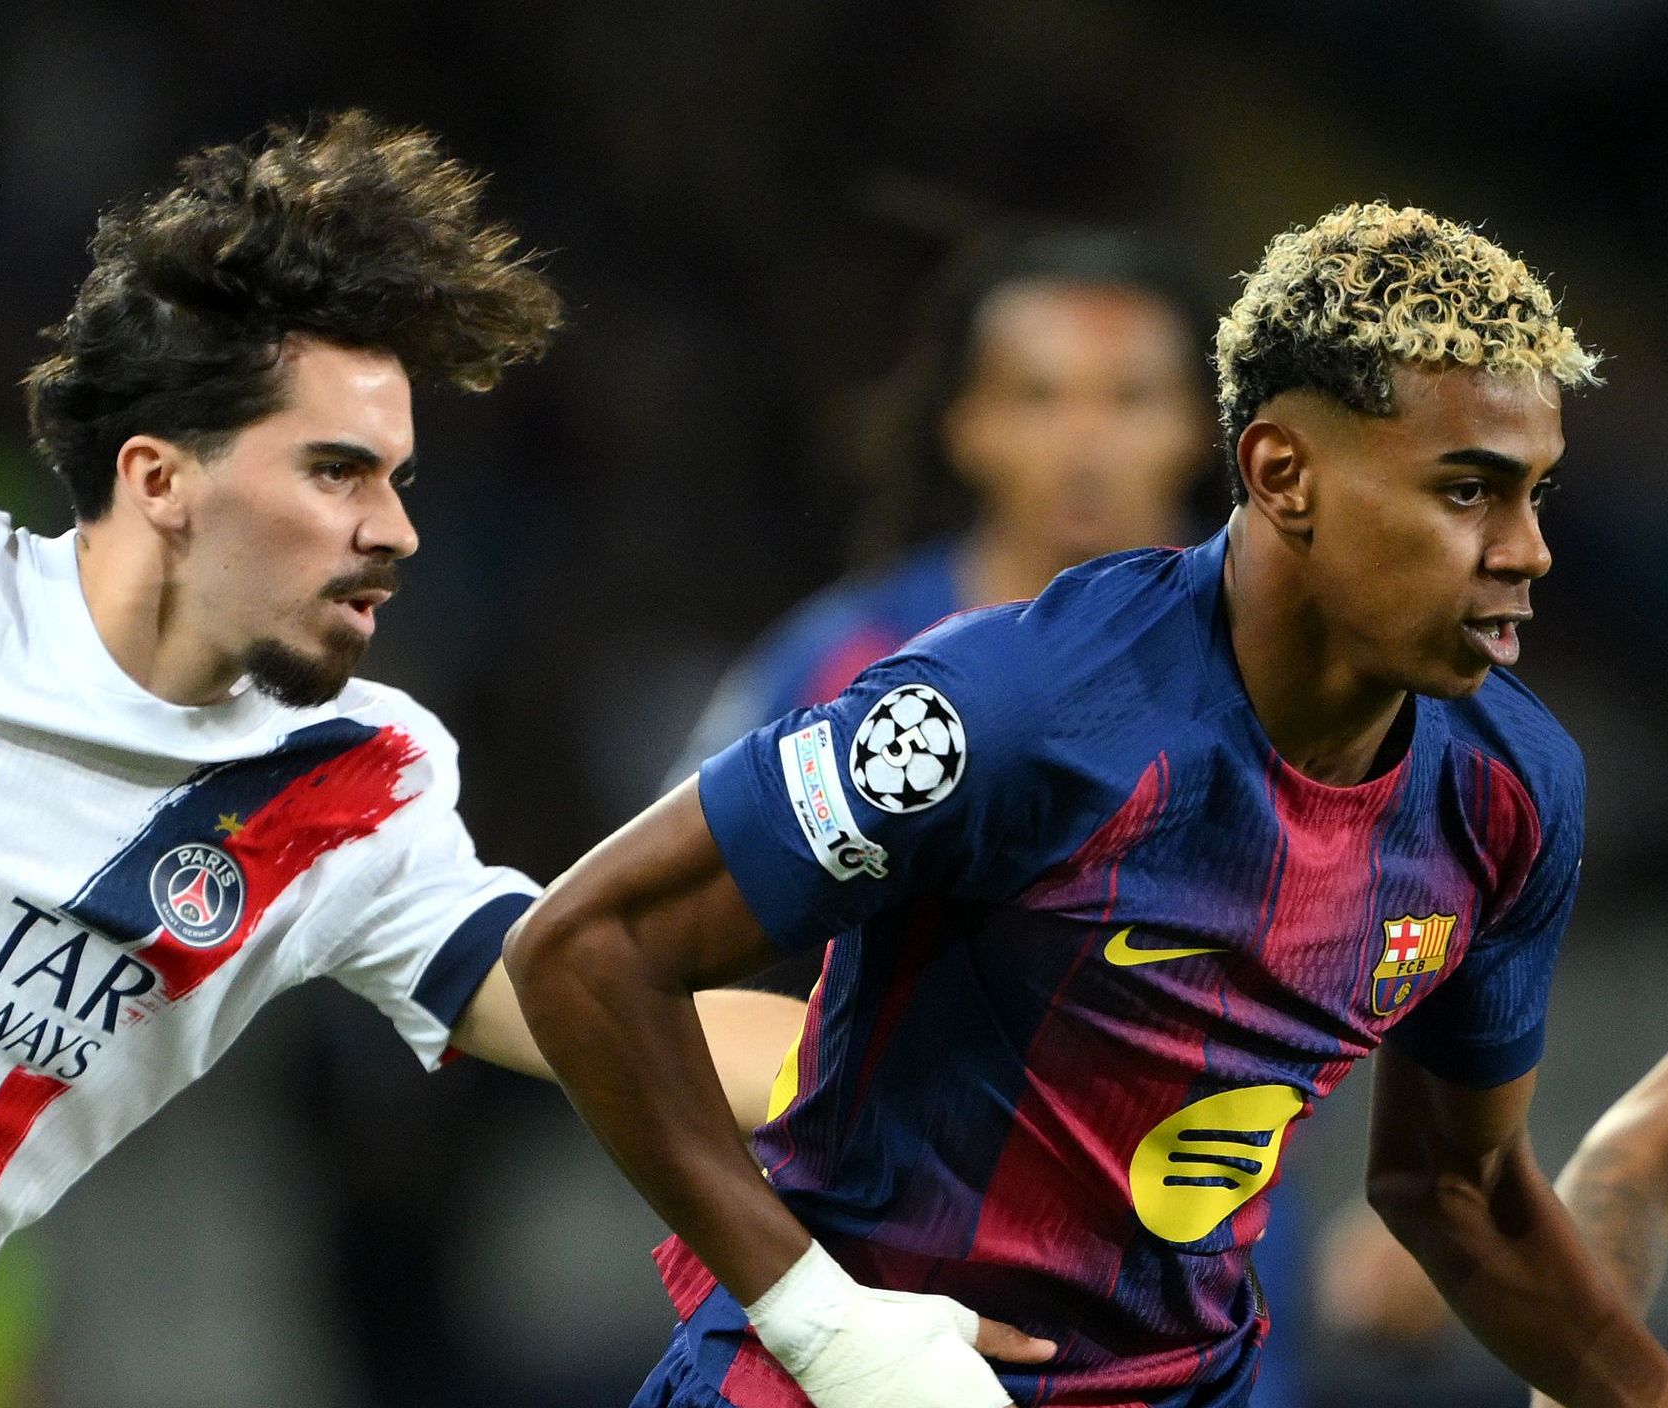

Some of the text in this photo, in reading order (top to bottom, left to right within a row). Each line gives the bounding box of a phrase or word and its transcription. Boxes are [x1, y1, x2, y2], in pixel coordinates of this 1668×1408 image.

[882, 726, 929, 768] 5
[799, 731, 837, 832] FOUNDATION
[177, 849, 236, 887] PARIS
[827, 829, 865, 869] 10
[1396, 960, 1426, 975] FCB
